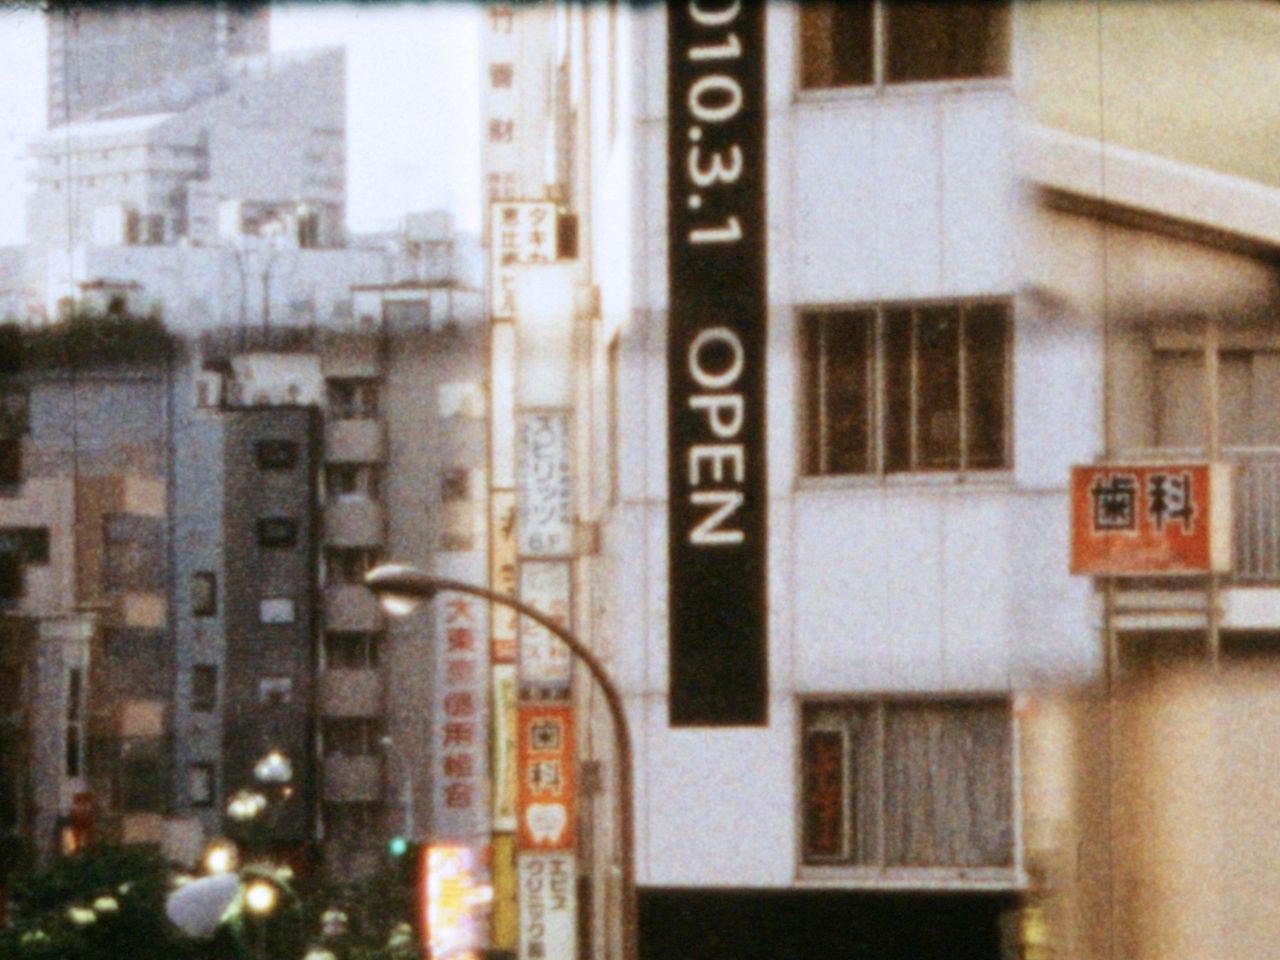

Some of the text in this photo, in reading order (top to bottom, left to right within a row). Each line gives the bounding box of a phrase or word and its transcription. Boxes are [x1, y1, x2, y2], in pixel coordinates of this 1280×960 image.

[688, 327, 745, 545] OPEN
[1088, 471, 1197, 536] 歯科
[527, 717, 564, 794] 歯科
